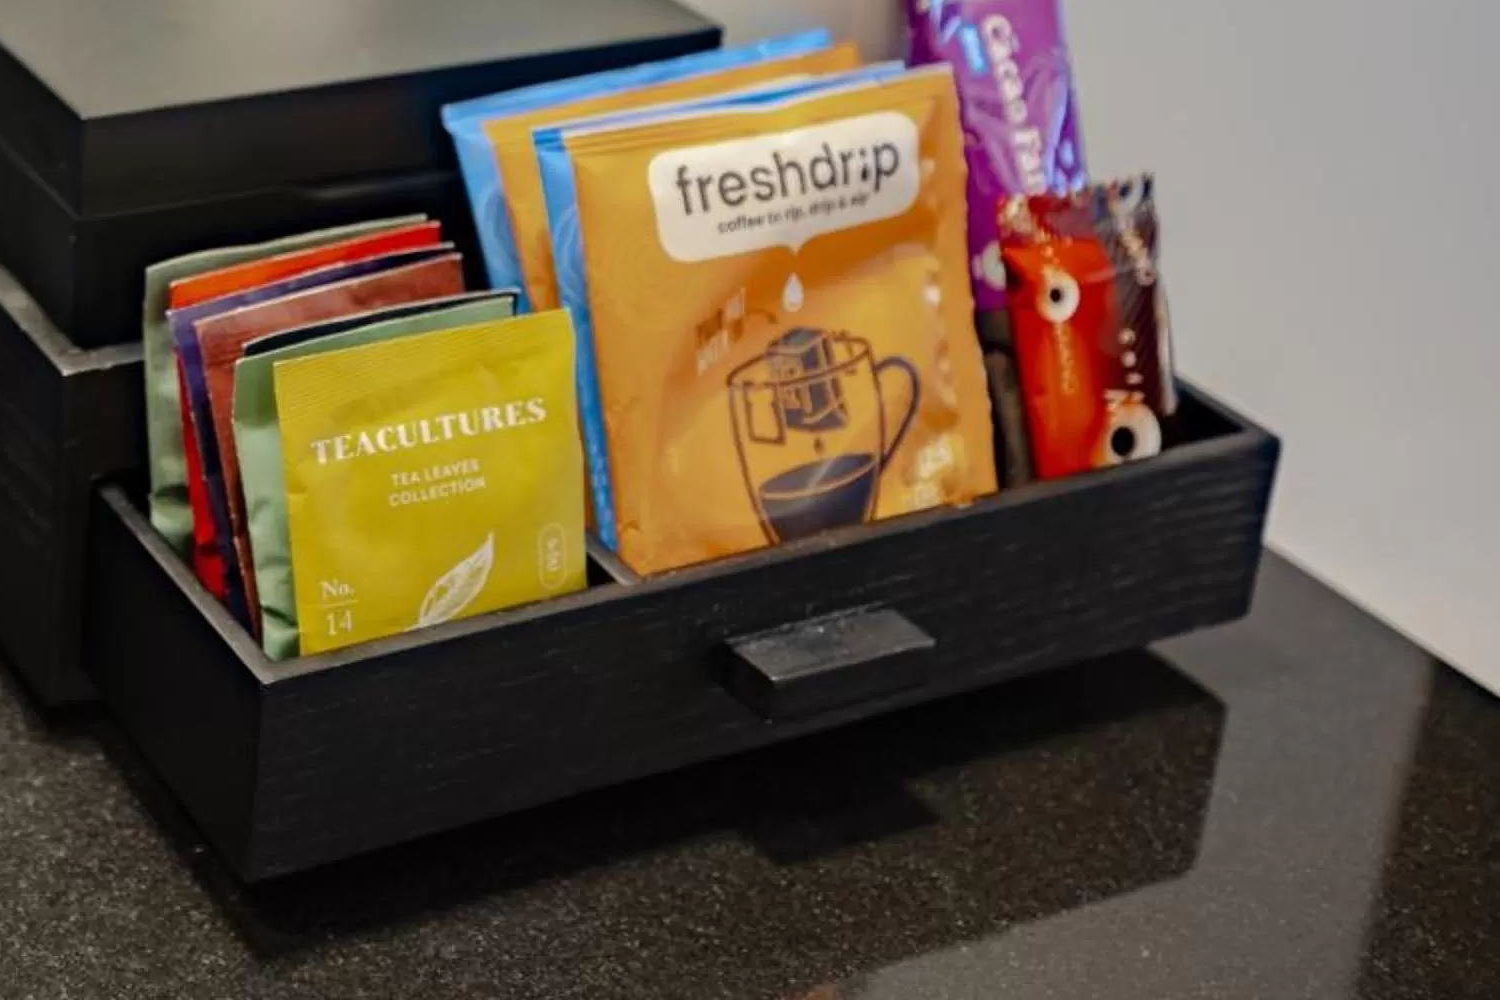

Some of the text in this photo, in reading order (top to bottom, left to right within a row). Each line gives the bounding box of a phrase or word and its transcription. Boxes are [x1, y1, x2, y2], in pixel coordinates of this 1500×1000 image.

[676, 141, 899, 216] freshdrip
[717, 211, 764, 234] coffee
[310, 397, 547, 466] TEACULTURES
[390, 458, 481, 487] TEA LEAVES
[389, 476, 485, 507] COLLECTION
[320, 578, 356, 598] No.
[326, 610, 353, 637] 14
